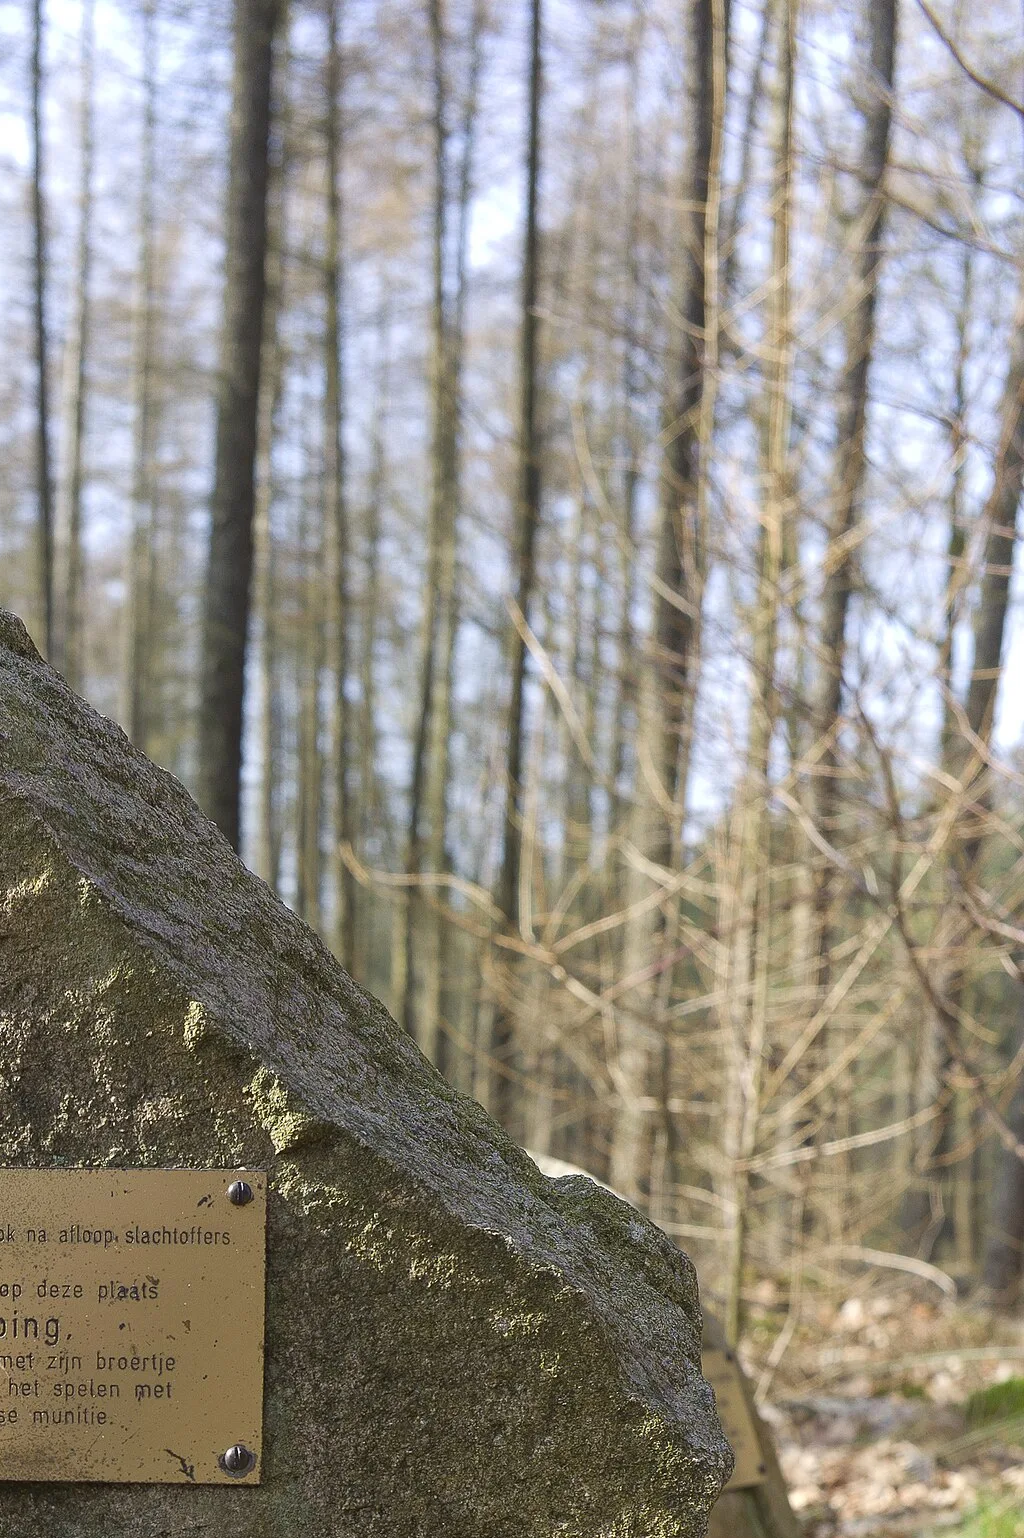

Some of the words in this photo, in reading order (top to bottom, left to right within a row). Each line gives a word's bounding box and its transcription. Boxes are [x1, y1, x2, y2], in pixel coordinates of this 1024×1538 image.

[27, 1228, 47, 1243] na
[125, 1226, 236, 1246] slachtoffers.
[0, 1283, 22, 1302] op
[37, 1280, 83, 1299] deze
[98, 1280, 159, 1303] plaats
[47, 1354, 82, 1374] zijn
[97, 1351, 176, 1376] broertje
[8, 1379, 40, 1397] het
[53, 1379, 120, 1399] spelen
[135, 1381, 173, 1401] met
[33, 1405, 114, 1426] munitie.
